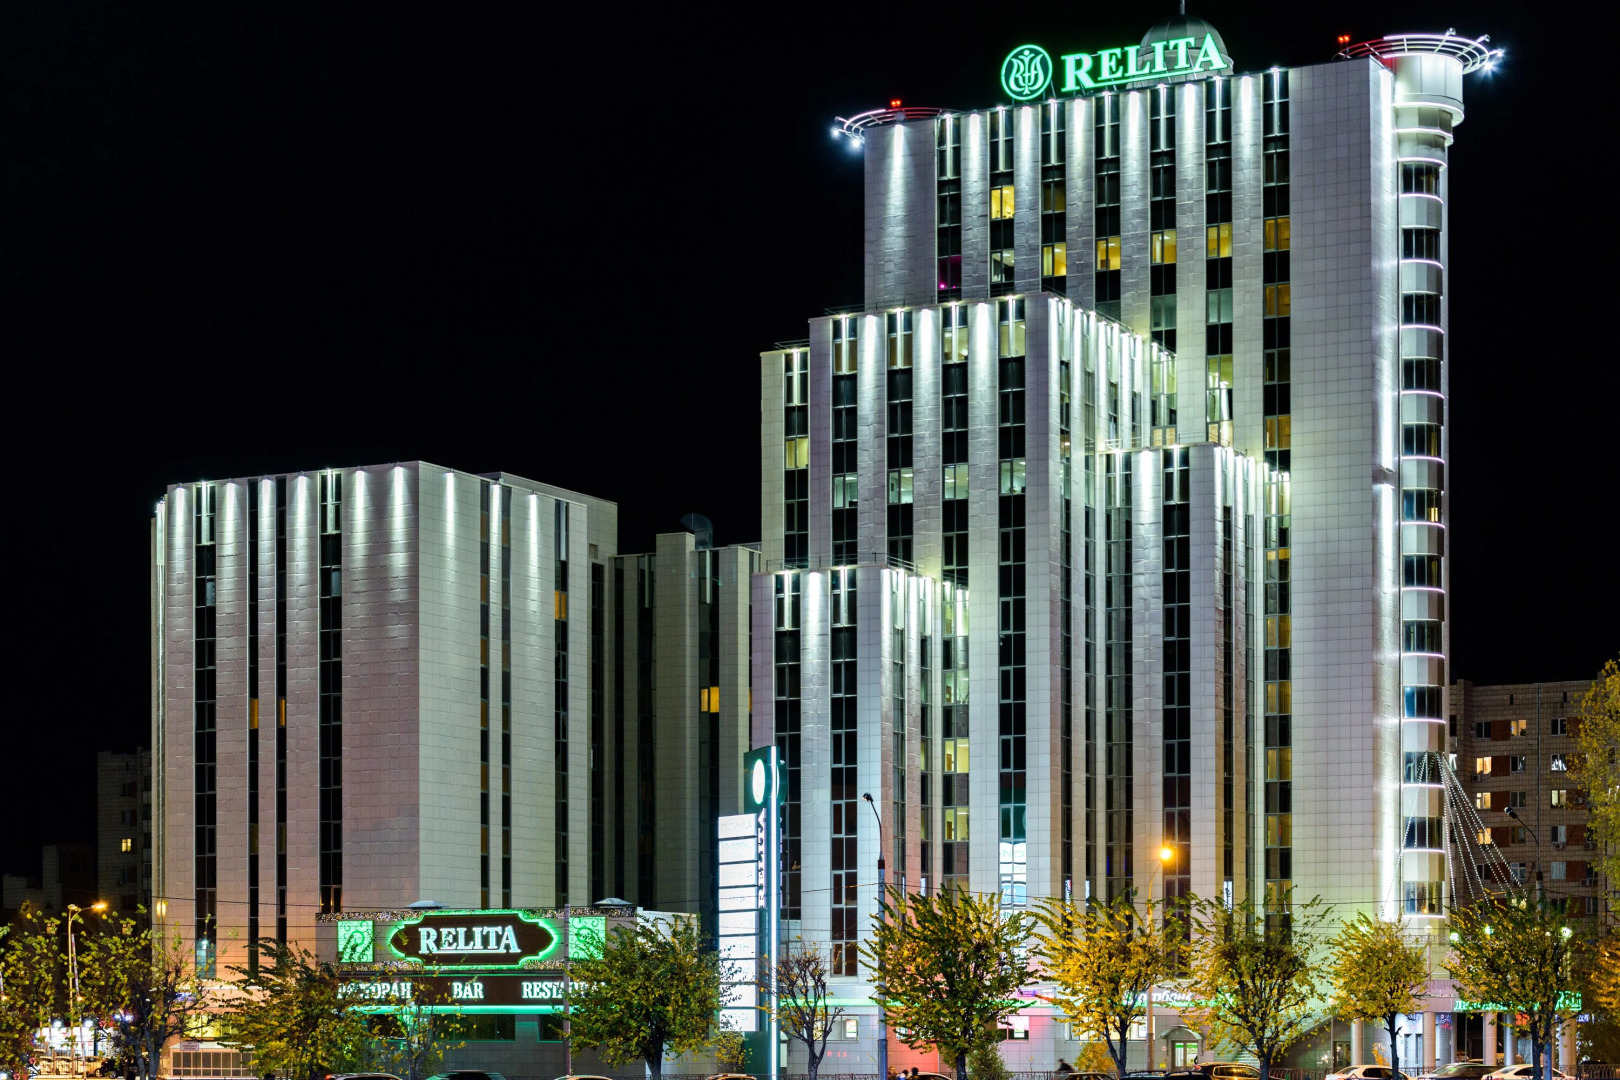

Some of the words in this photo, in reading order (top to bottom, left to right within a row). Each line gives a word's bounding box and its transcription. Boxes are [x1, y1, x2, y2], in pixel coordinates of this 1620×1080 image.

[1060, 32, 1228, 92] RELITA
[418, 925, 521, 953] RELITA
[452, 982, 484, 998] BAR
